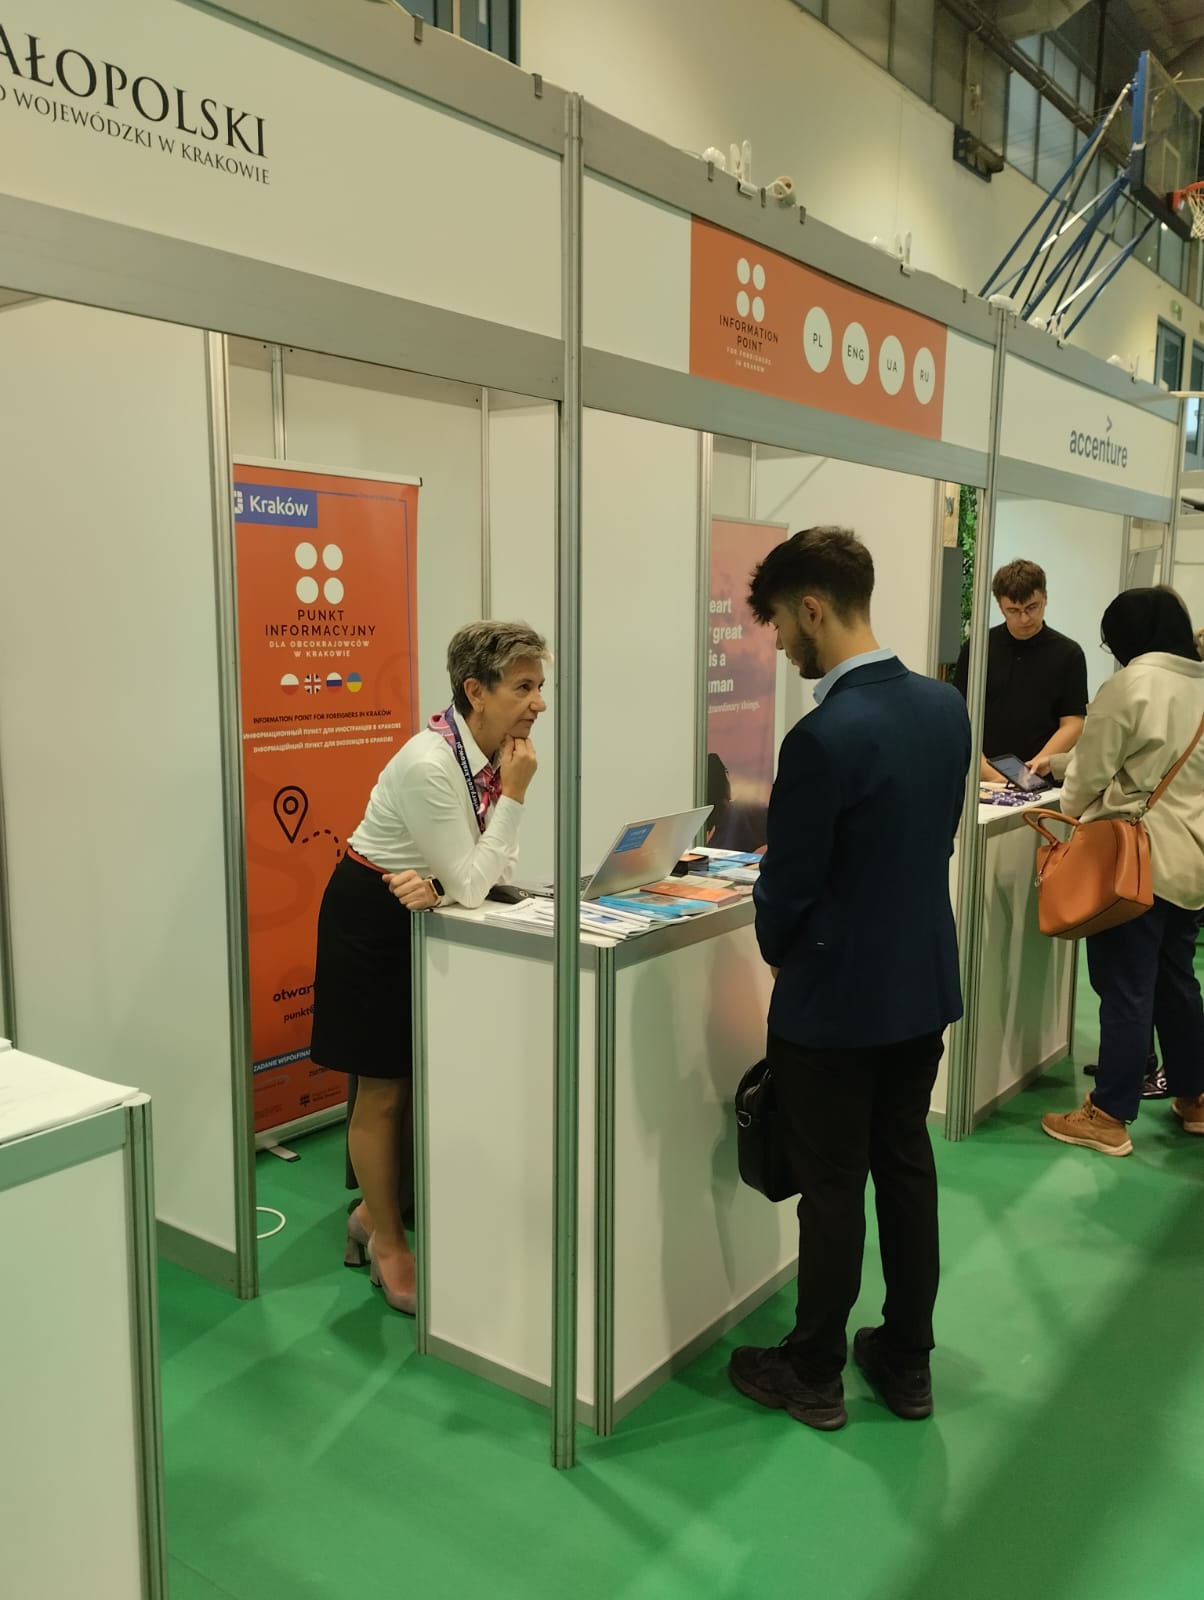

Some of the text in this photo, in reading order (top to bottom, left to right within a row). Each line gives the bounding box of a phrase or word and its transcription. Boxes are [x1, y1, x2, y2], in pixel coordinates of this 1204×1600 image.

[13, 88, 152, 148] WOJEWÓDZKI
[158, 135, 175, 154] W
[182, 143, 270, 185] KRAKOWIE
[719, 315, 778, 343] INFORMATION
[737, 335, 763, 352] POINT
[813, 333, 823, 348] PL
[847, 344, 865, 361] ENG
[886, 360, 898, 373] UA
[920, 369, 930, 383] RU
[1070, 430, 1128, 468] accenture
[249, 495, 309, 517] Kraków
[297, 609, 345, 621] PUNKT
[265, 624, 376, 637] INFORMACYJNY
[712, 624, 743, 644] great
[269, 639, 370, 648] DLA OBCOKRAJOWCÓW
[293, 650, 351, 658] W KRAKOWIE
[708, 649, 726, 667] is a
[253, 715, 293, 724] INFORMATION
[294, 714, 312, 722] POINT
[326, 711, 358, 719] FOREIGNERS
[253, 1060, 278, 1072] ZADANIE
